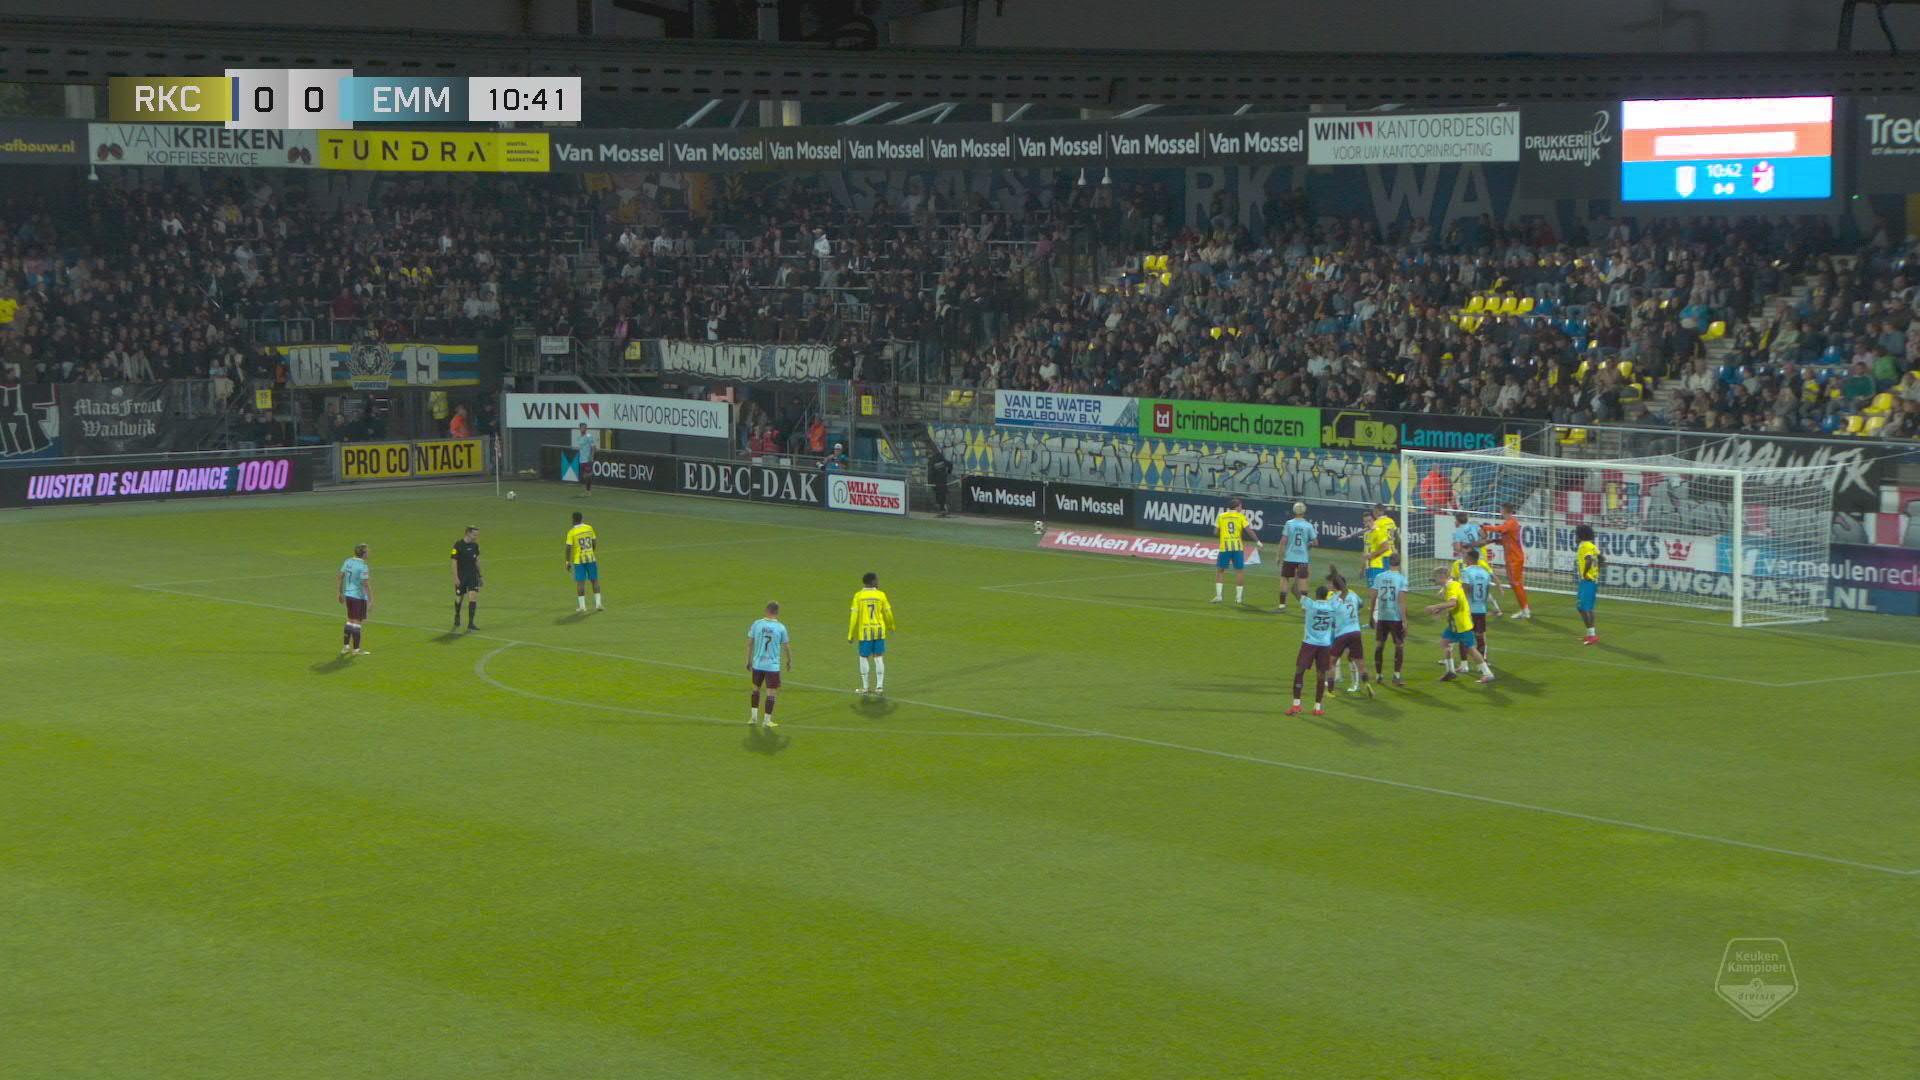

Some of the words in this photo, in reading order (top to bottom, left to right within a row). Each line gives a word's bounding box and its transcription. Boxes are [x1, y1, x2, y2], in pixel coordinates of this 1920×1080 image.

[1313, 122, 1355, 141] WINI
[1376, 116, 1515, 138] KANTOORDESIGN
[328, 138, 487, 162] TUNDRA
[674, 143, 709, 161] Van
[713, 141, 763, 161] Mossel
[769, 141, 794, 160] Van
[797, 139, 842, 160] Mossel
[849, 140, 874, 159] Van
[877, 138, 924, 159] Mossel
[931, 138, 957, 159] Van
[960, 137, 1011, 158] Mossel
[1019, 137, 1047, 157] Van
[1050, 134, 1102, 156] Mossel
[1111, 135, 1140, 156] Van
[1145, 132, 1200, 155] Mossel
[1209, 133, 1240, 154] Van
[1244, 129, 1303, 153] Mossel
[1333, 144, 1361, 160] VOOR
[1381, 142, 1493, 159] KANTOORINRICHTING
[147, 150, 259, 166] KOFFIESERVICE
[555, 143, 593, 161] Van
[600, 143, 665, 163] Mossel
[402, 345, 439, 385] 19
[1004, 394, 1031, 408] VAN
[1036, 396, 1053, 410] DE
[1057, 399, 1102, 413] WATER
[522, 402, 579, 420] WINI
[613, 403, 722, 430] KANTOORDESIGN.
[1004, 408, 1076, 421] STAALBOUW
[1176, 410, 1250, 434] trimbach
[1400, 423, 1496, 449] Lammers
[344, 448, 381, 476] PRO
[386, 443, 474, 474] CONTACT
[27, 474, 95, 500] LUISTER
[96, 472, 119, 496] DE
[120, 469, 173, 495] SLAM!
[175, 466, 230, 492] DANCE
[235, 459, 290, 492] 1000
[592, 460, 626, 479] OORE
[629, 463, 655, 481] DRV
[683, 462, 818, 502] EDEC-DAK
[847, 480, 880, 494] WILLY
[848, 493, 900, 509] NAESSENS
[970, 486, 992, 503] Van
[996, 488, 1036, 508] Mossel
[1056, 494, 1078, 511] Van
[1081, 496, 1123, 515] Mossel
[1143, 500, 1264, 531] MANDEMRS
[1227, 522, 1235, 534] 9
[1322, 520, 1347, 537] huis
[1054, 531, 1128, 550] Keuken
[1130, 537, 1220, 561] Kampioe
[868, 604, 876, 620] 7
[1312, 616, 1329, 631] 25
[764, 635, 772, 651] 7
